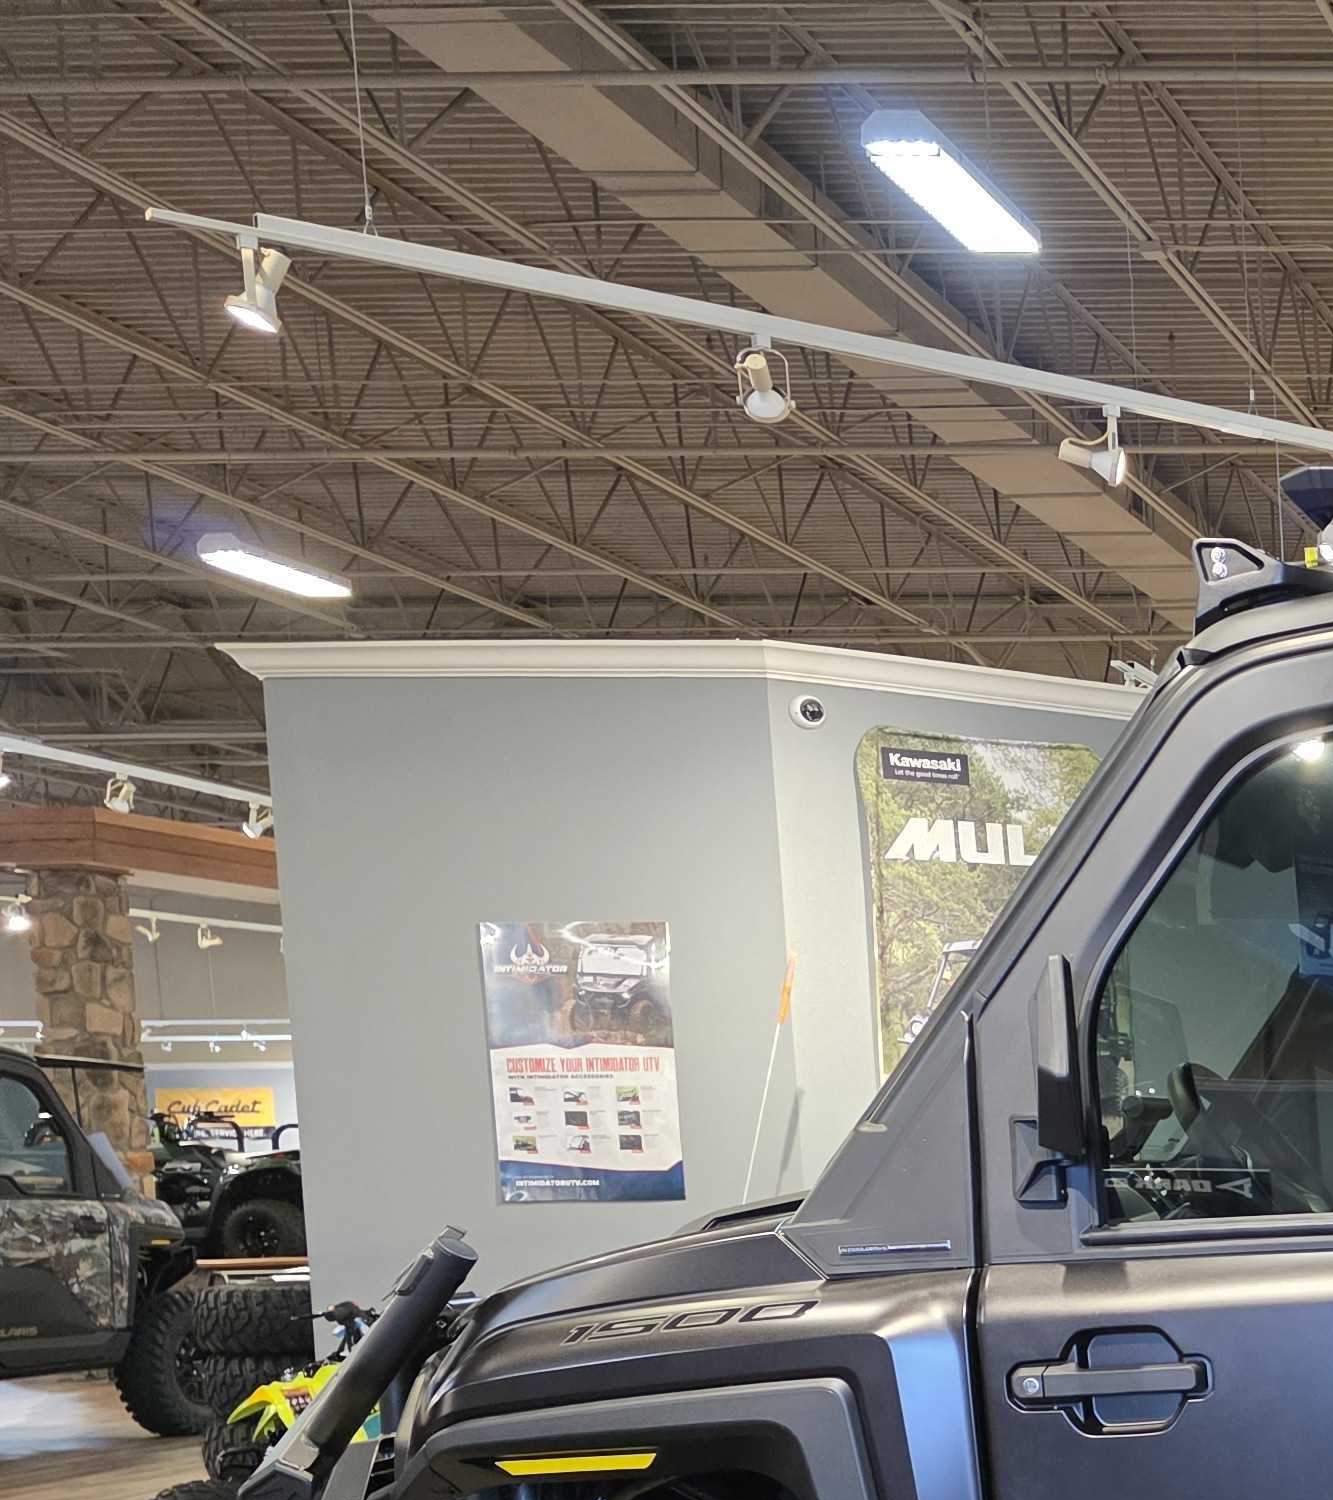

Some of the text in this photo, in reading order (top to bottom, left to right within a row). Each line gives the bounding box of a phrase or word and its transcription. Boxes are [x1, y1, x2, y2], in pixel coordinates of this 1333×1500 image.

[889, 753, 962, 772] Kawasaki
[506, 1055, 661, 1073] CUSTOMIZE YOUR INTIMIDATOR UTV
[202, 1100, 261, 1115] Cadet
[559, 1300, 820, 1345] 1500
